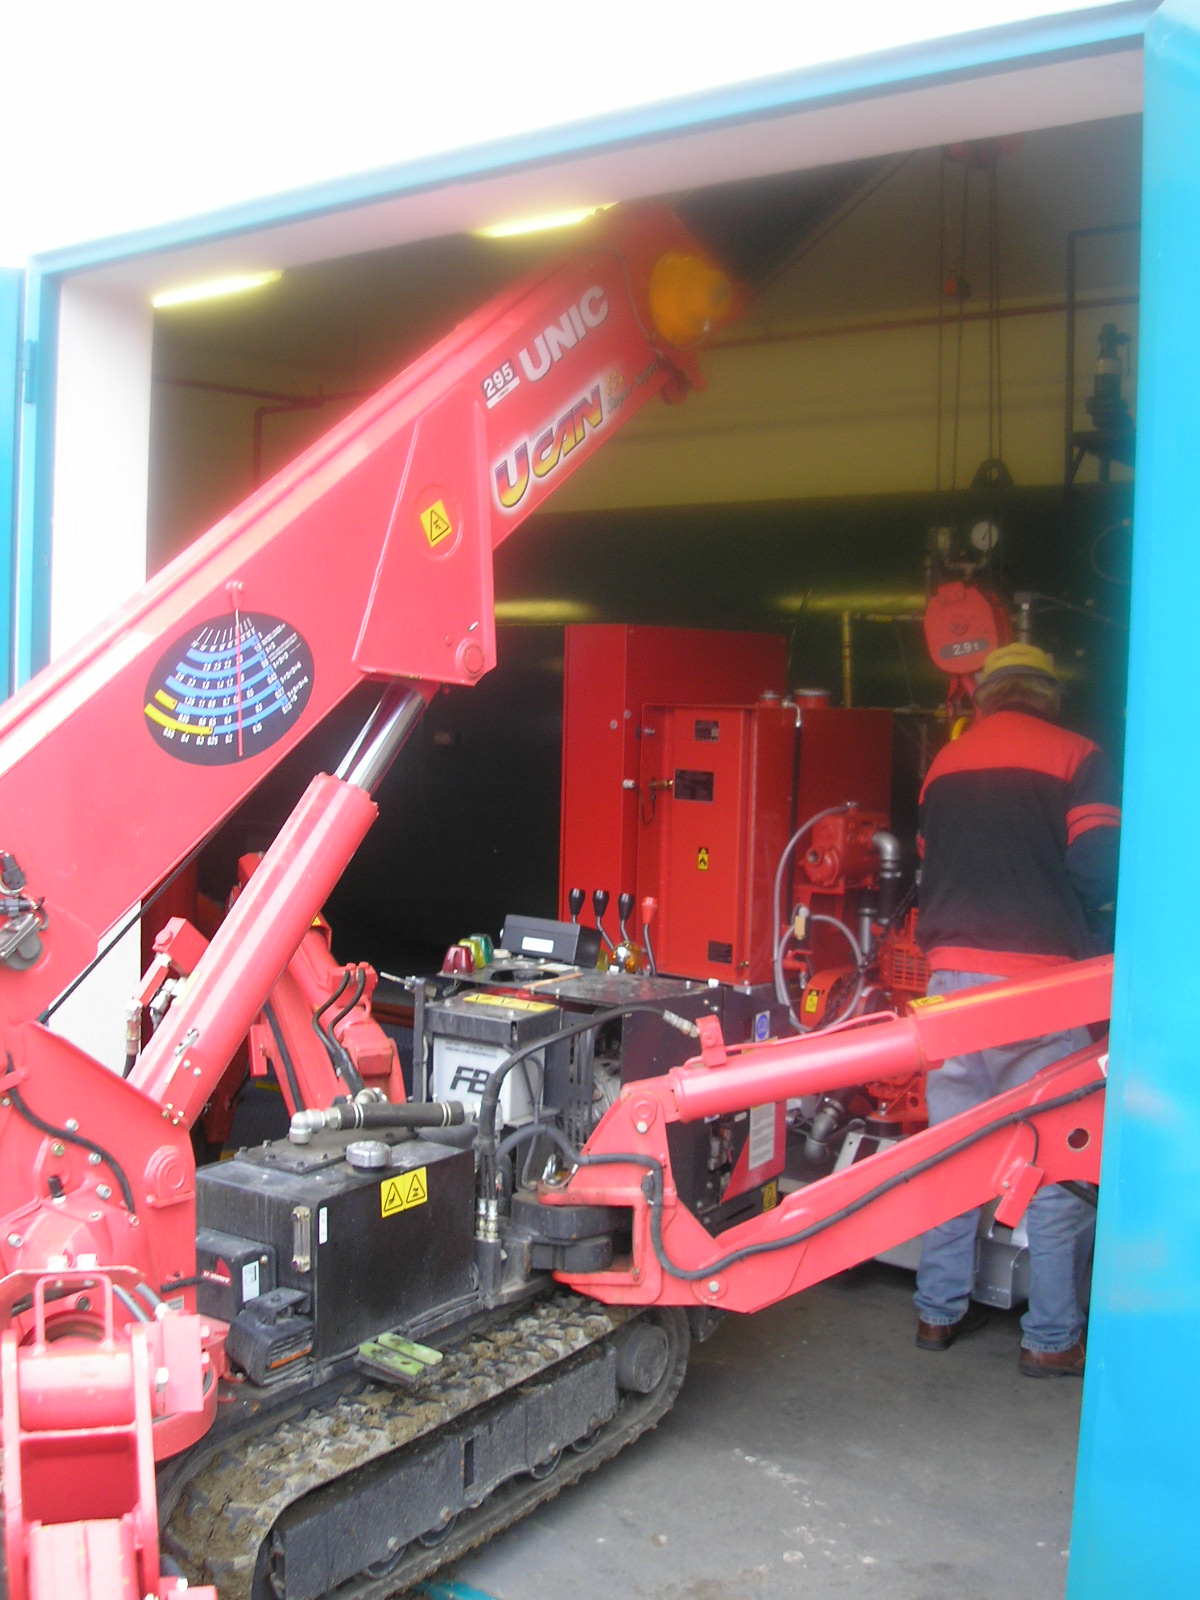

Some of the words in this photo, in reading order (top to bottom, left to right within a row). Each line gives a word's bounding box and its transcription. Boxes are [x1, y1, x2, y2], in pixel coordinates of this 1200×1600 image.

[518, 286, 609, 382] UNIC
[484, 362, 514, 399] 295
[952, 642, 971, 655] 2.9
